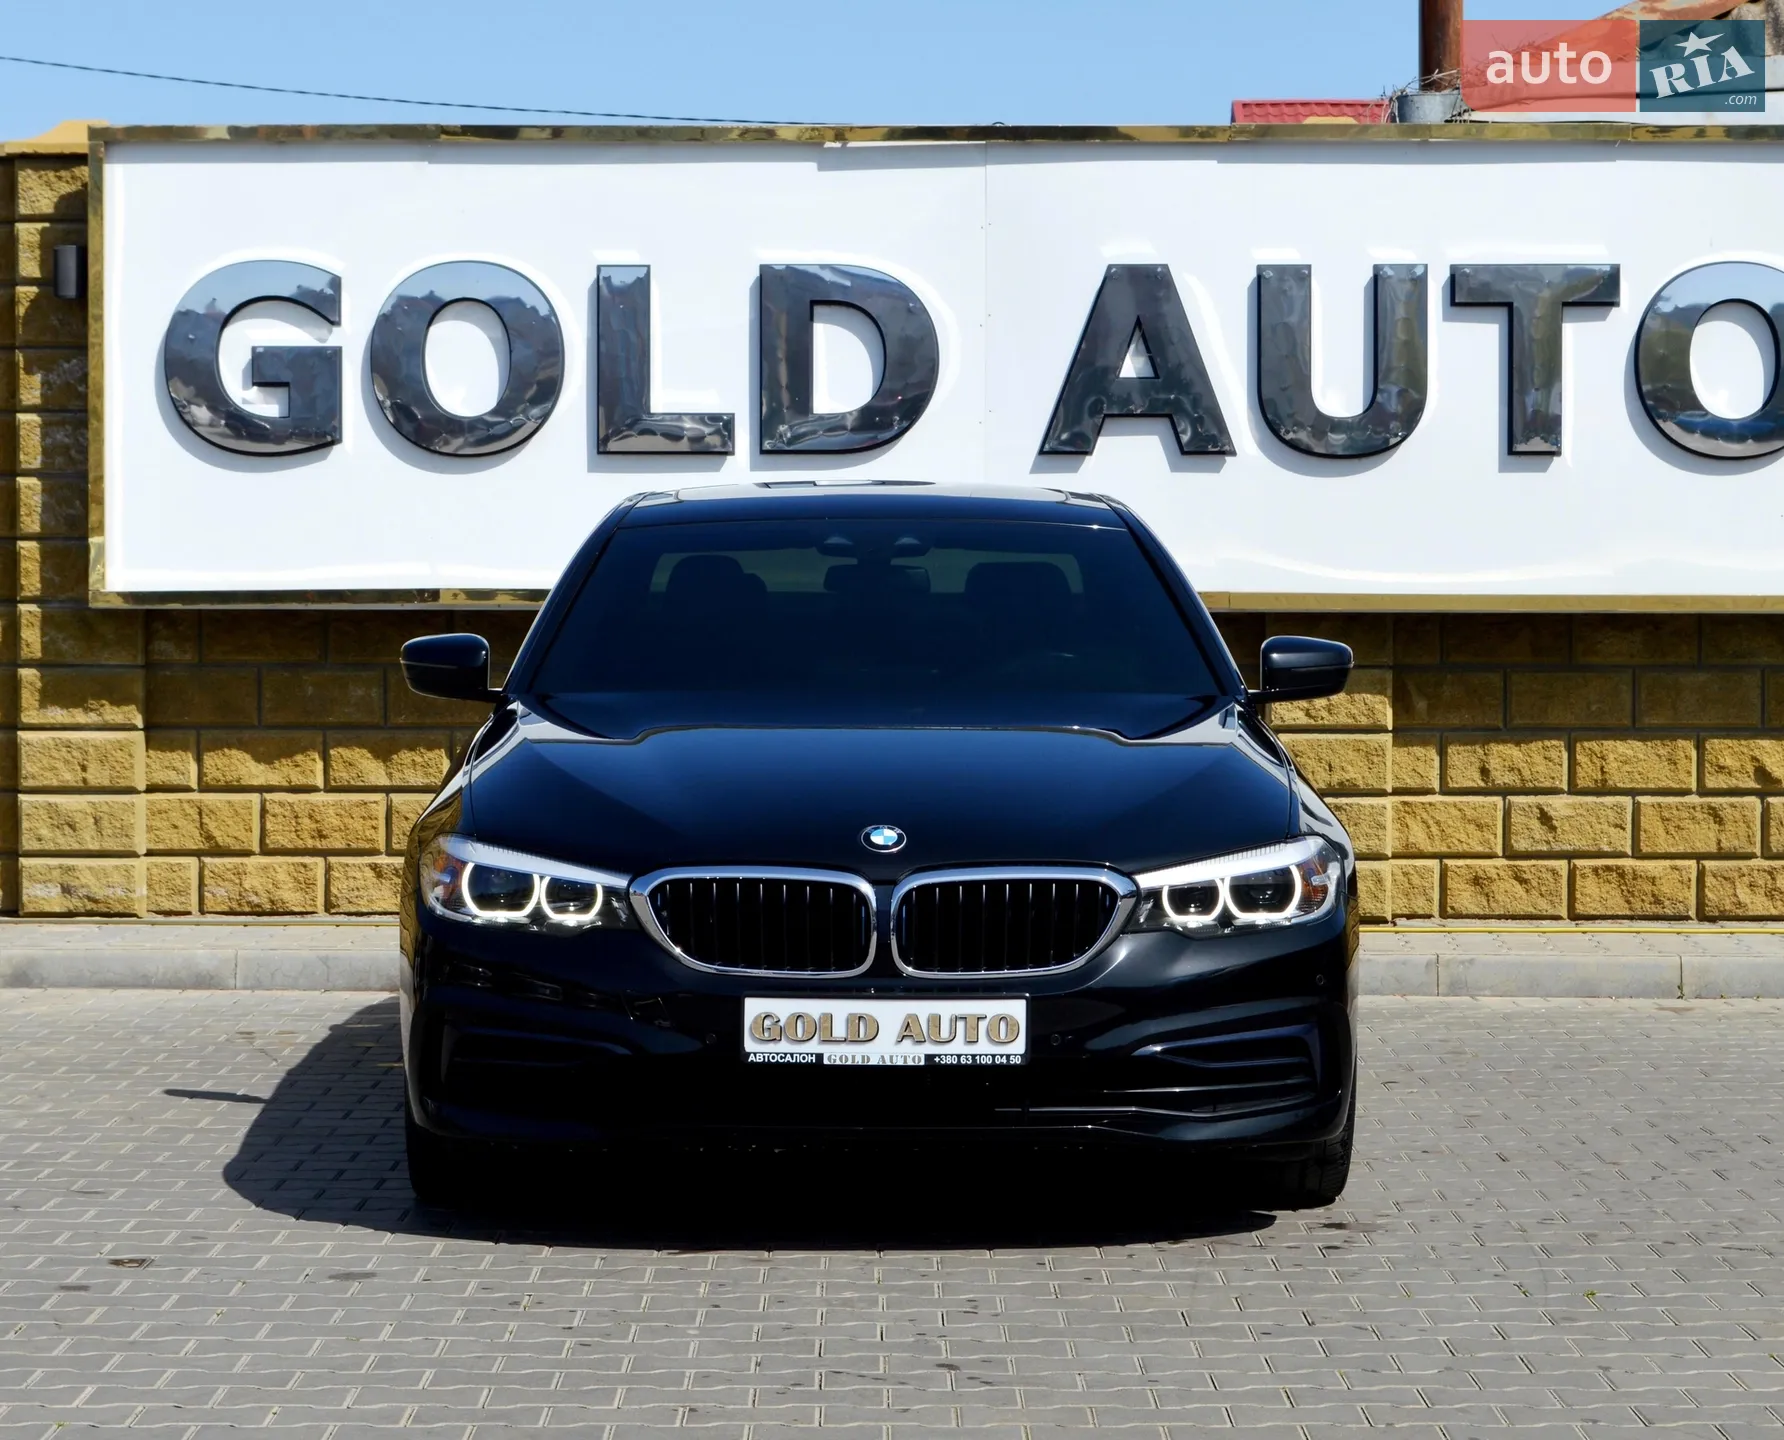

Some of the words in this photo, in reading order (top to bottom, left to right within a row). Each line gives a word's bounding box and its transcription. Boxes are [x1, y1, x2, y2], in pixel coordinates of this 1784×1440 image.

[164, 260, 940, 456] GOLD
[1038, 262, 1784, 460] AUTO
[751, 1012, 878, 1042] GOLD
[898, 1013, 1020, 1043] AUTO
[748, 1053, 816, 1063] АВТОСАЛОН
[827, 1054, 870, 1064] GOLD
[877, 1055, 922, 1065] AUTO
[934, 1055, 958, 1064] +380
[960, 1055, 972, 1064] 63
[975, 1055, 993, 1064] 100
[995, 1055, 1007, 1064] 04
[1009, 1055, 1021, 1064] 50
